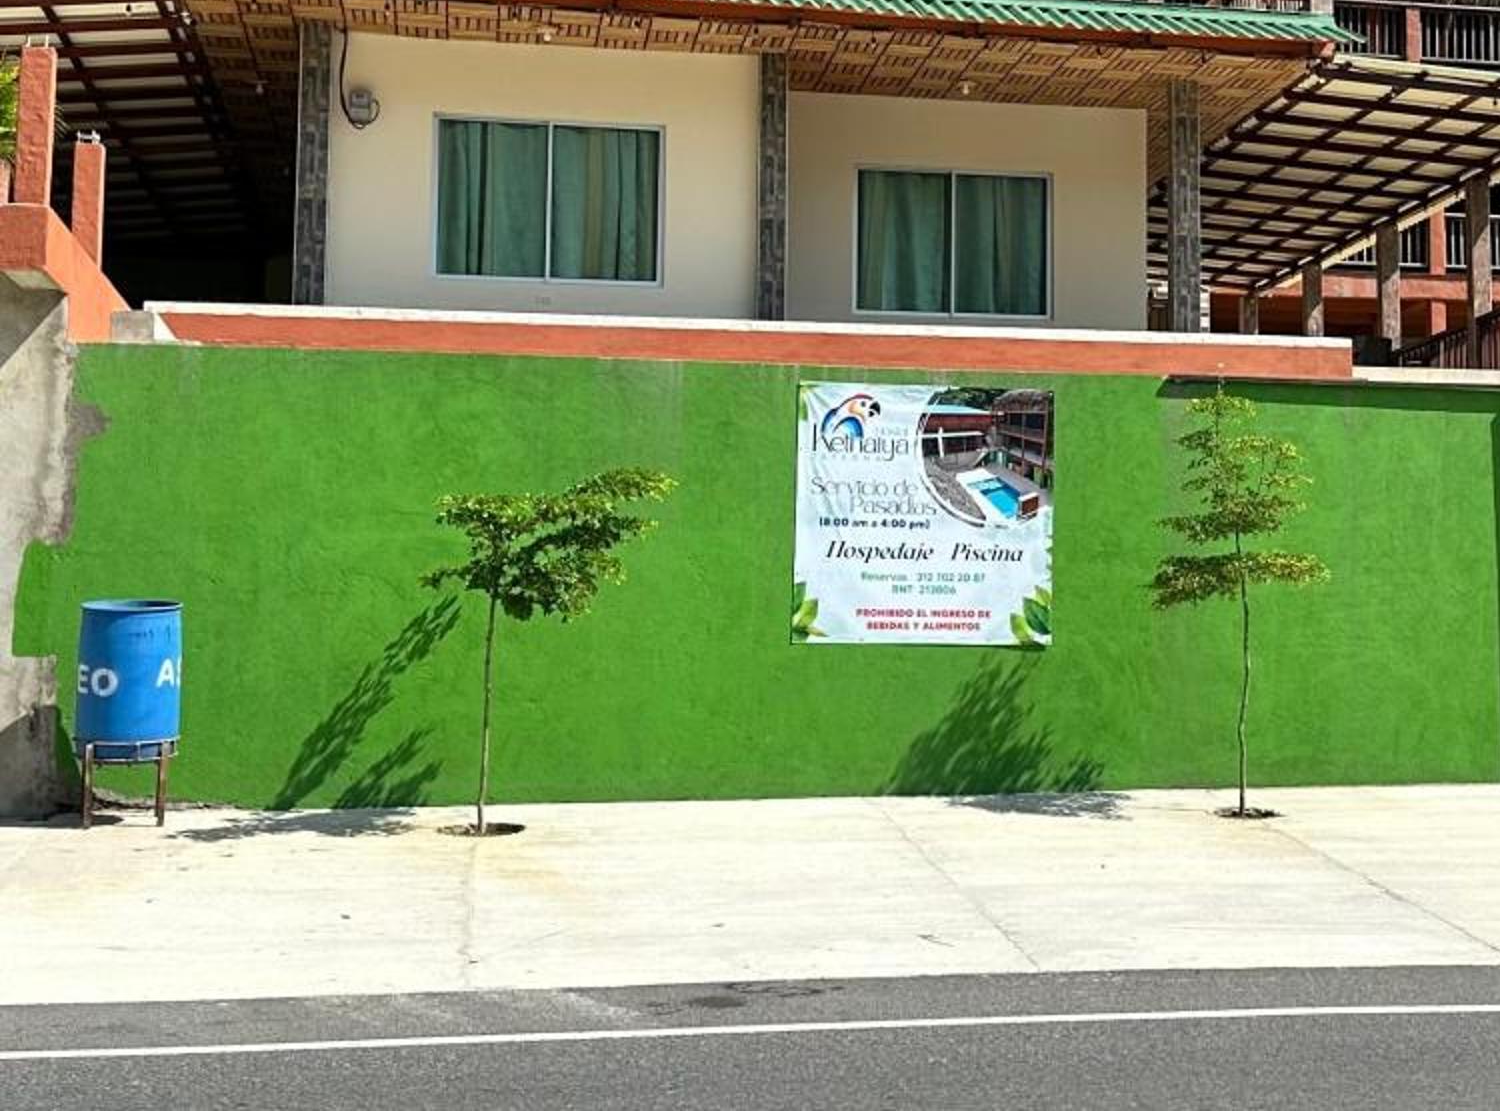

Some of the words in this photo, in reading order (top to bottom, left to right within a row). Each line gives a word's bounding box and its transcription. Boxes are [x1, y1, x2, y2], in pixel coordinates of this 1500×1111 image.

[893, 479, 919, 496] de
[826, 540, 934, 564] Hospedaje
[951, 542, 1024, 562] Piscina
[855, 608, 914, 618] PROHIBIDO
[916, 609, 929, 618] EL
[931, 609, 976, 619] INGRESO
[977, 609, 991, 619] DE
[866, 622, 910, 630] BEBIDAS
[922, 622, 981, 631] ALIMENTOS
